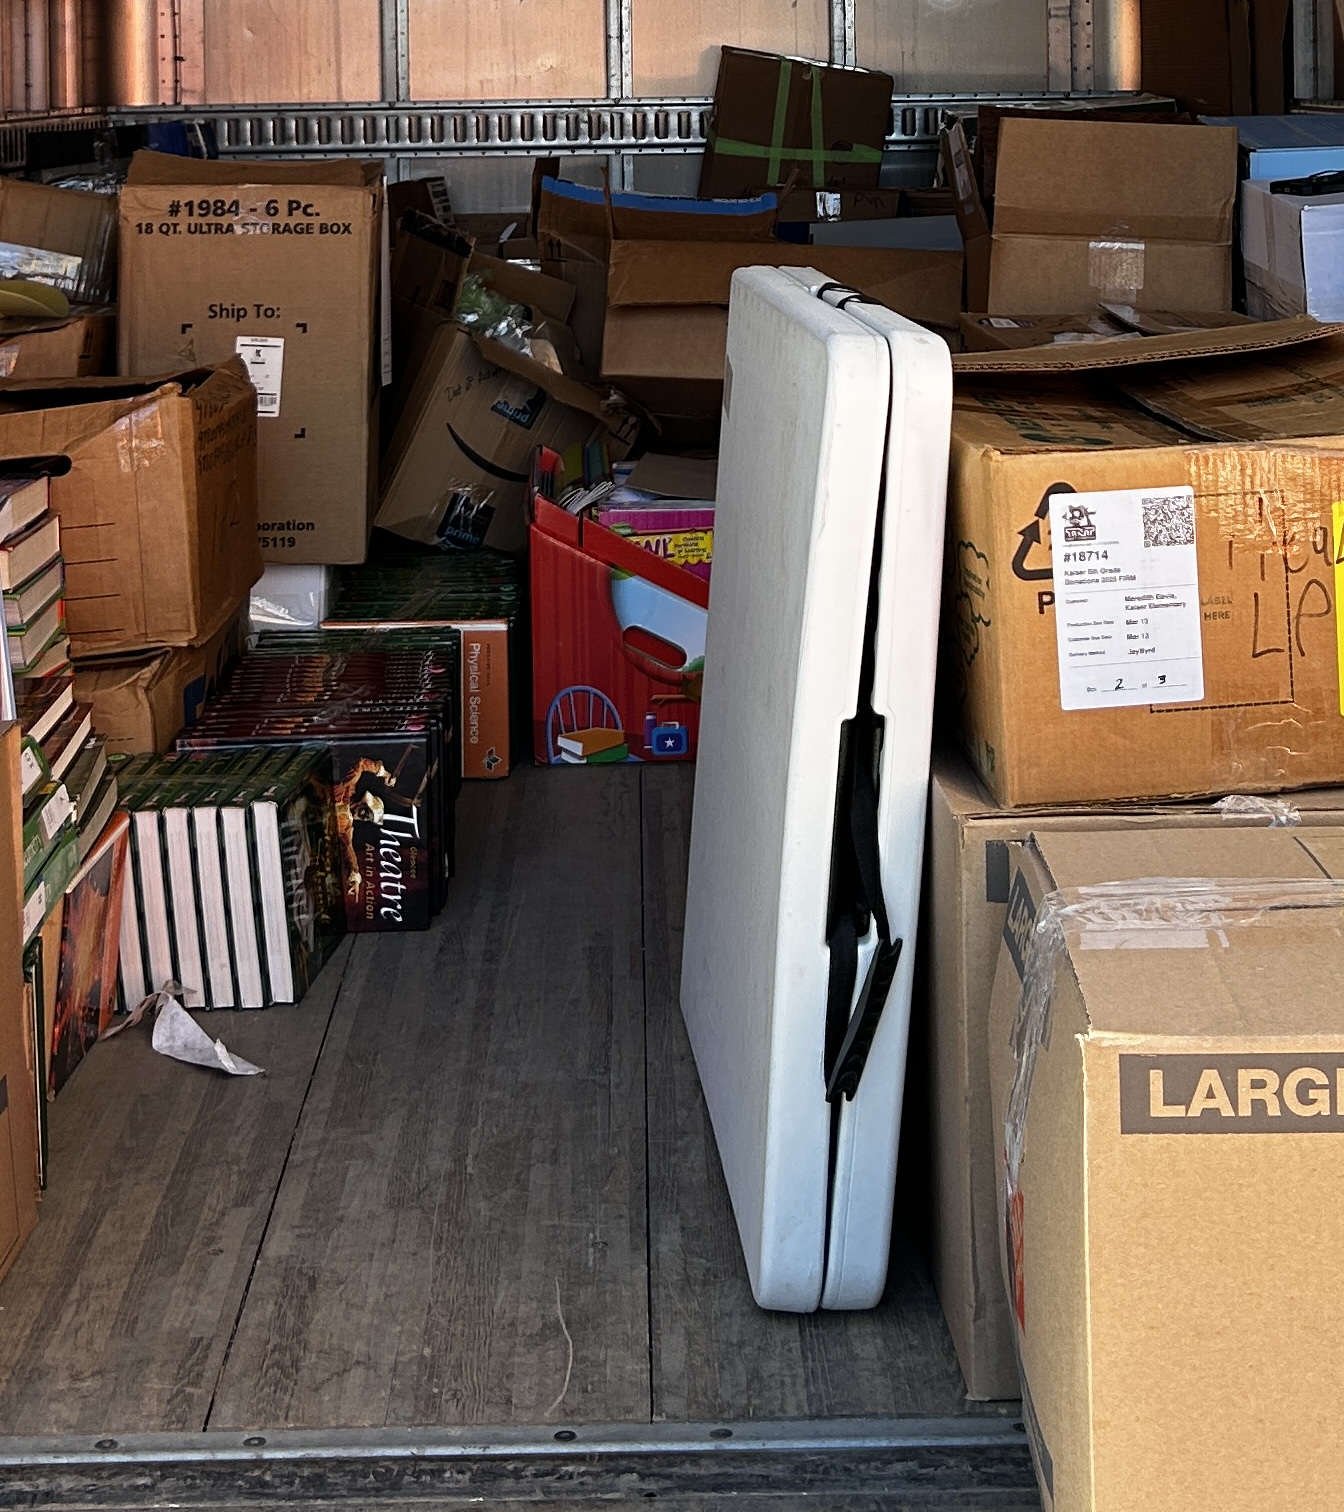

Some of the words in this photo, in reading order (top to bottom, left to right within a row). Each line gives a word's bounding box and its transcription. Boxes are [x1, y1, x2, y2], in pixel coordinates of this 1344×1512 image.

[169, 200, 240, 217] #1984
[266, 200, 279, 217] 6
[288, 200, 320, 217] Pc.
[136, 223, 153, 234] 18
[159, 223, 182, 235] QT.
[188, 223, 234, 234] ULTRA
[241, 223, 314, 234] STORAGE
[319, 223, 352, 234] BOX
[208, 304, 247, 321] Ship
[255, 304, 281, 319] To:
[445, 525, 480, 543] prime
[1064, 550, 1108, 562] #18714
[1065, 569, 1086, 577] Kaiser
[1201, 595, 1232, 607] LABEL
[1205, 610, 1230, 620] HERE
[467, 643, 481, 692] Physical
[1115, 679, 1124, 691] 2
[470, 696, 481, 744] Science
[365, 842, 375, 862] Art
[365, 865, 374, 878] in
[379, 804, 420, 923] Theatre
[365, 884, 375, 920] Action
